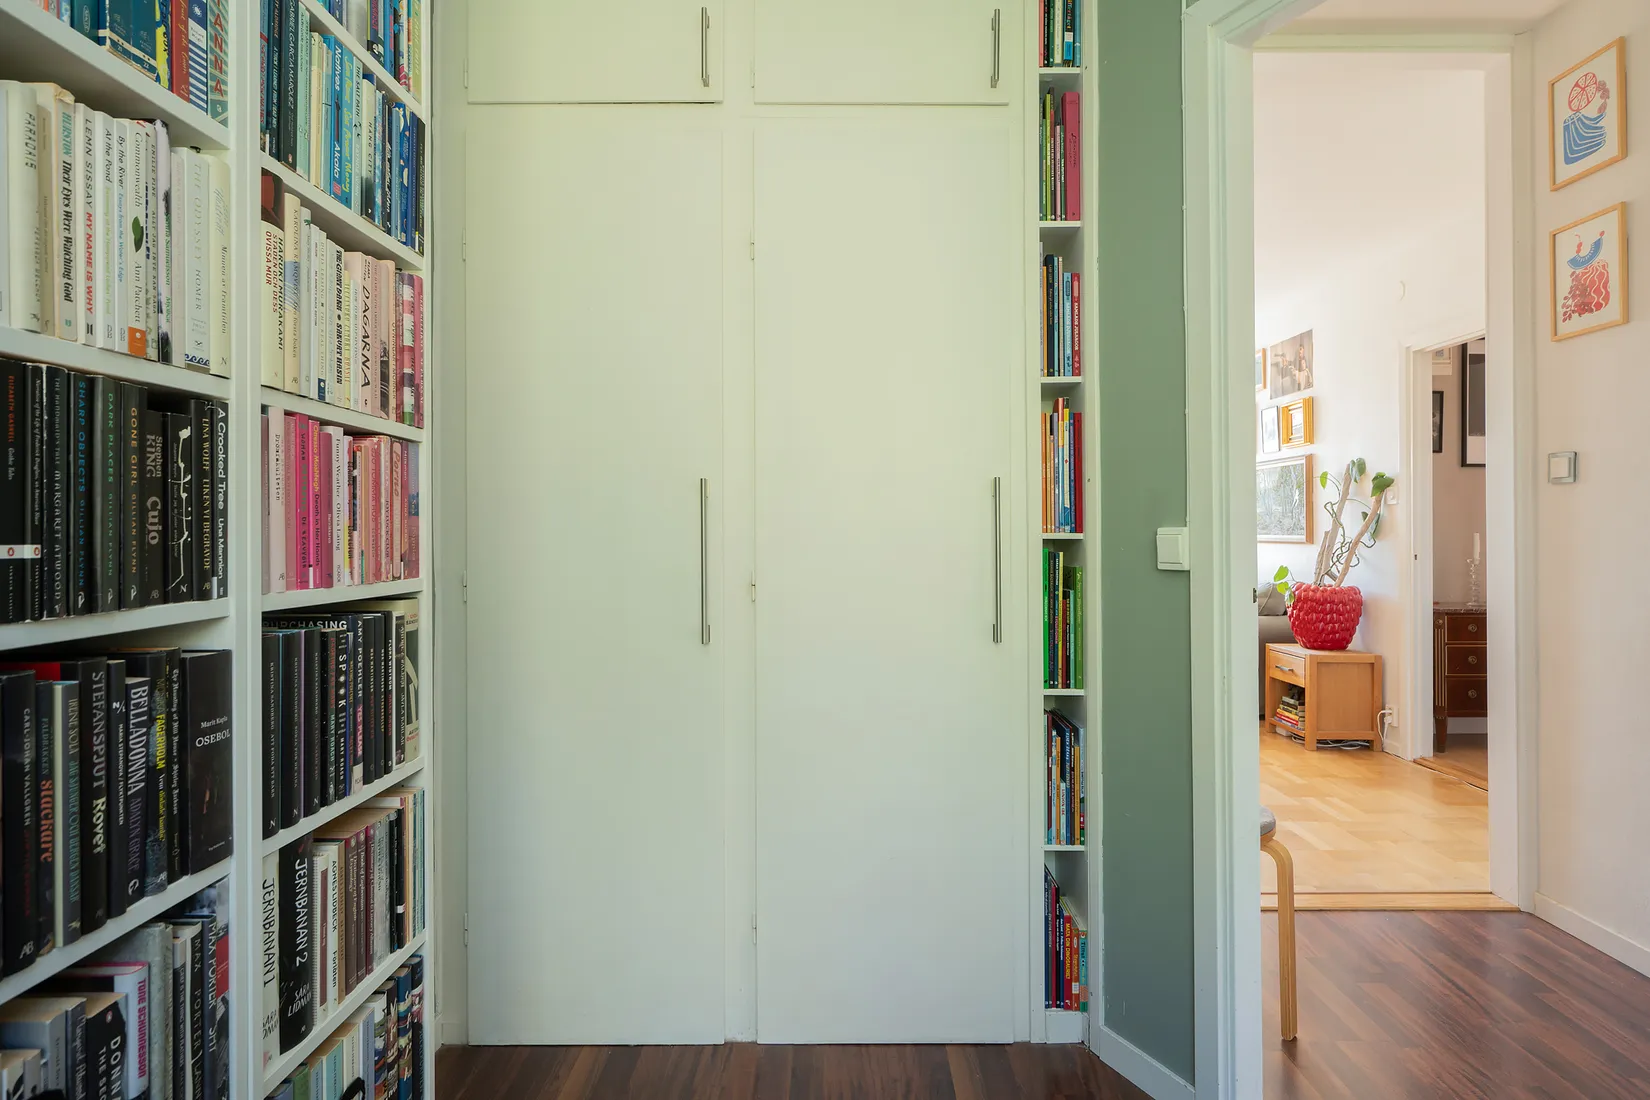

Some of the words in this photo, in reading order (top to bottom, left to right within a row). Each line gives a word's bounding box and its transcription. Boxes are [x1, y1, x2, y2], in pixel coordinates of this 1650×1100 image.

[25, 112, 36, 170] PARADAIS
[62, 112, 73, 158] HURSTON
[105, 129, 112, 138] At
[117, 136, 125, 147] By
[63, 160, 71, 188] Their
[85, 161, 93, 208] SISSAY
[134, 132, 143, 207] Commonwealth
[342, 162, 351, 193] Money
[61, 188, 72, 208] Eyes
[63, 210, 72, 233] Were
[86, 212, 93, 230] MY
[62, 236, 72, 280] Watching
[86, 271, 93, 282] IS
[134, 261, 142, 282] Ann
[64, 282, 73, 302] God
[134, 285, 142, 323] Patchett
[361, 285, 370, 388] DAGARNA
[218, 408, 225, 418] A
[146, 435, 155, 478] KING
[155, 436, 163, 477] Stephen
[218, 422, 226, 478] Crooked
[54, 470, 62, 540] MARGARET
[203, 510, 210, 520] VI
[218, 482, 226, 509] Tree
[147, 496, 162, 545] Cujo
[203, 522, 211, 570] BEGRAVDE
[54, 544, 62, 600] ATWOOD
[127, 686, 148, 795] BELLADONNA
[195, 728, 230, 747] OSEBOL
[39, 780, 55, 862] stackare
[93, 796, 107, 855] Rovet
[129, 798, 142, 837] ADALYN
[295, 858, 308, 951] JERNBANAN
[262, 878, 276, 976] JERNBANAN
[296, 952, 308, 967] 2
[264, 976, 275, 988] 1
